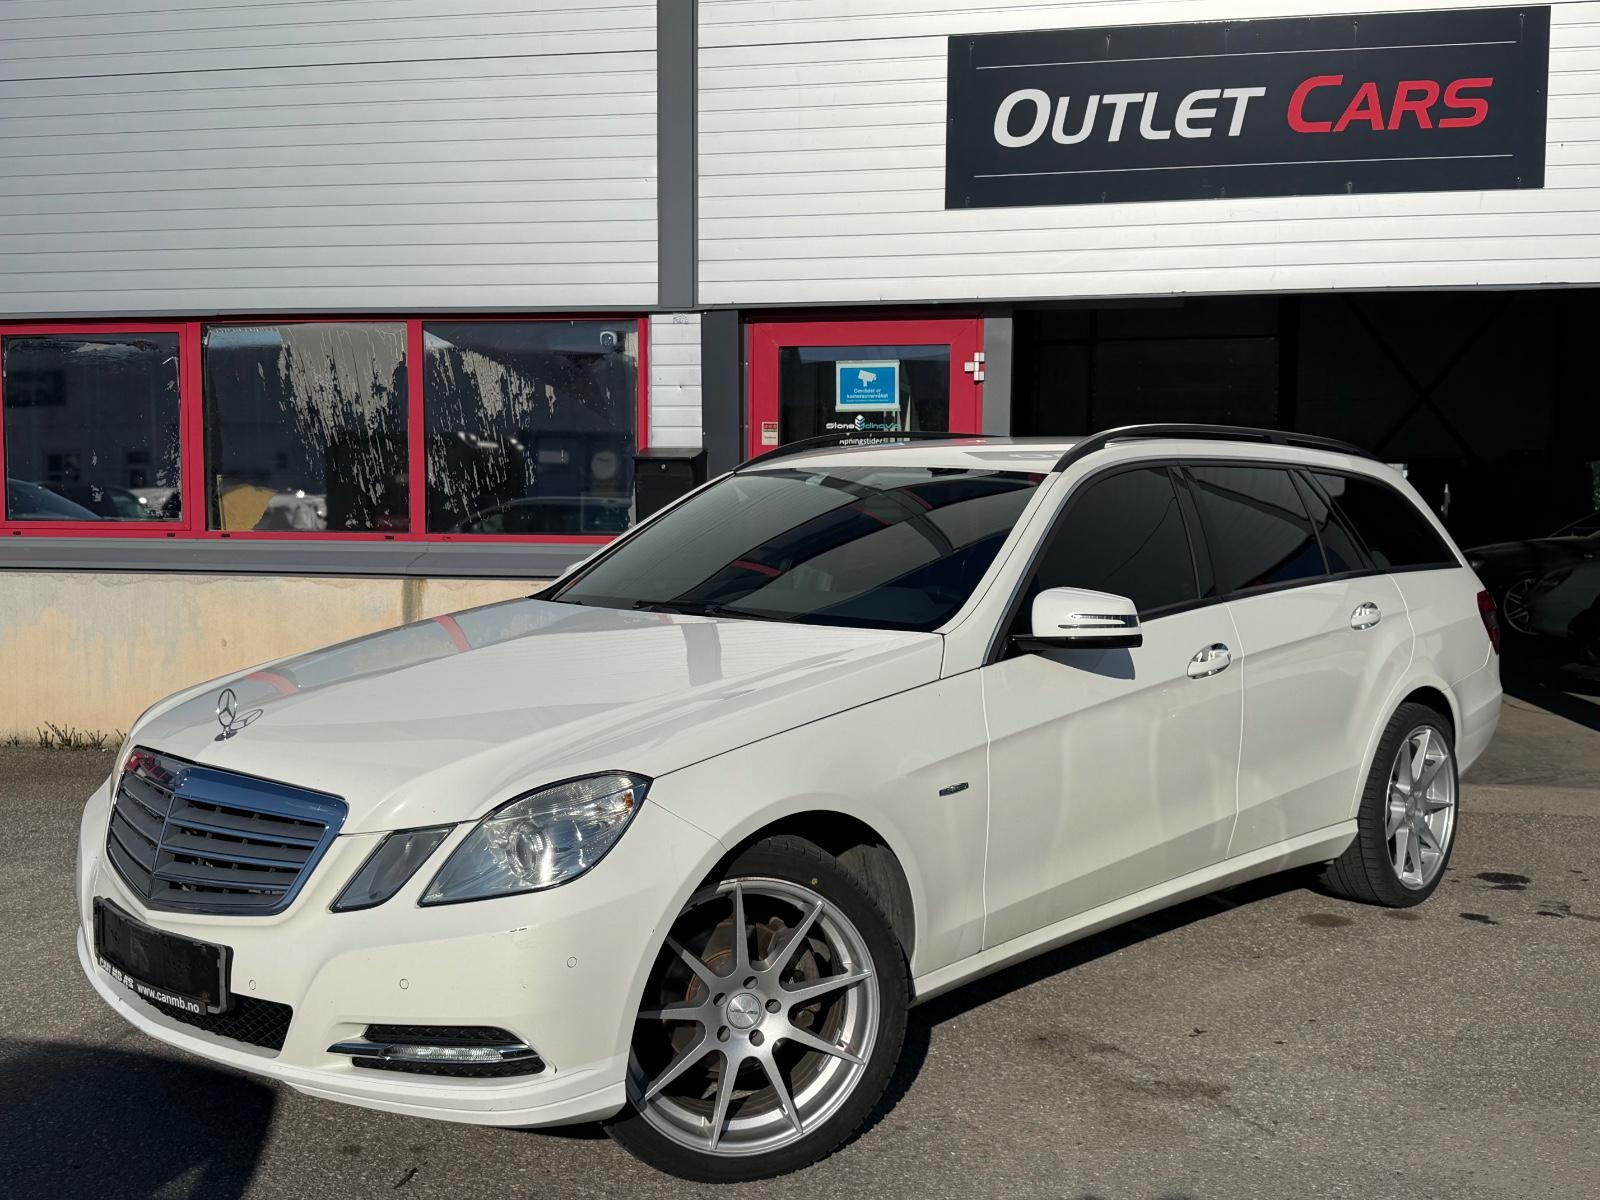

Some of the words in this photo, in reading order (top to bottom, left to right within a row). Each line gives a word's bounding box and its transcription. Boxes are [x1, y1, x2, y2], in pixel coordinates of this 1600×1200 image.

[994, 87, 1266, 147] OUTLET
[1288, 75, 1492, 132] CARS
[111, 966, 122, 982] MB
[136, 983, 200, 1014] www.canmb.no
